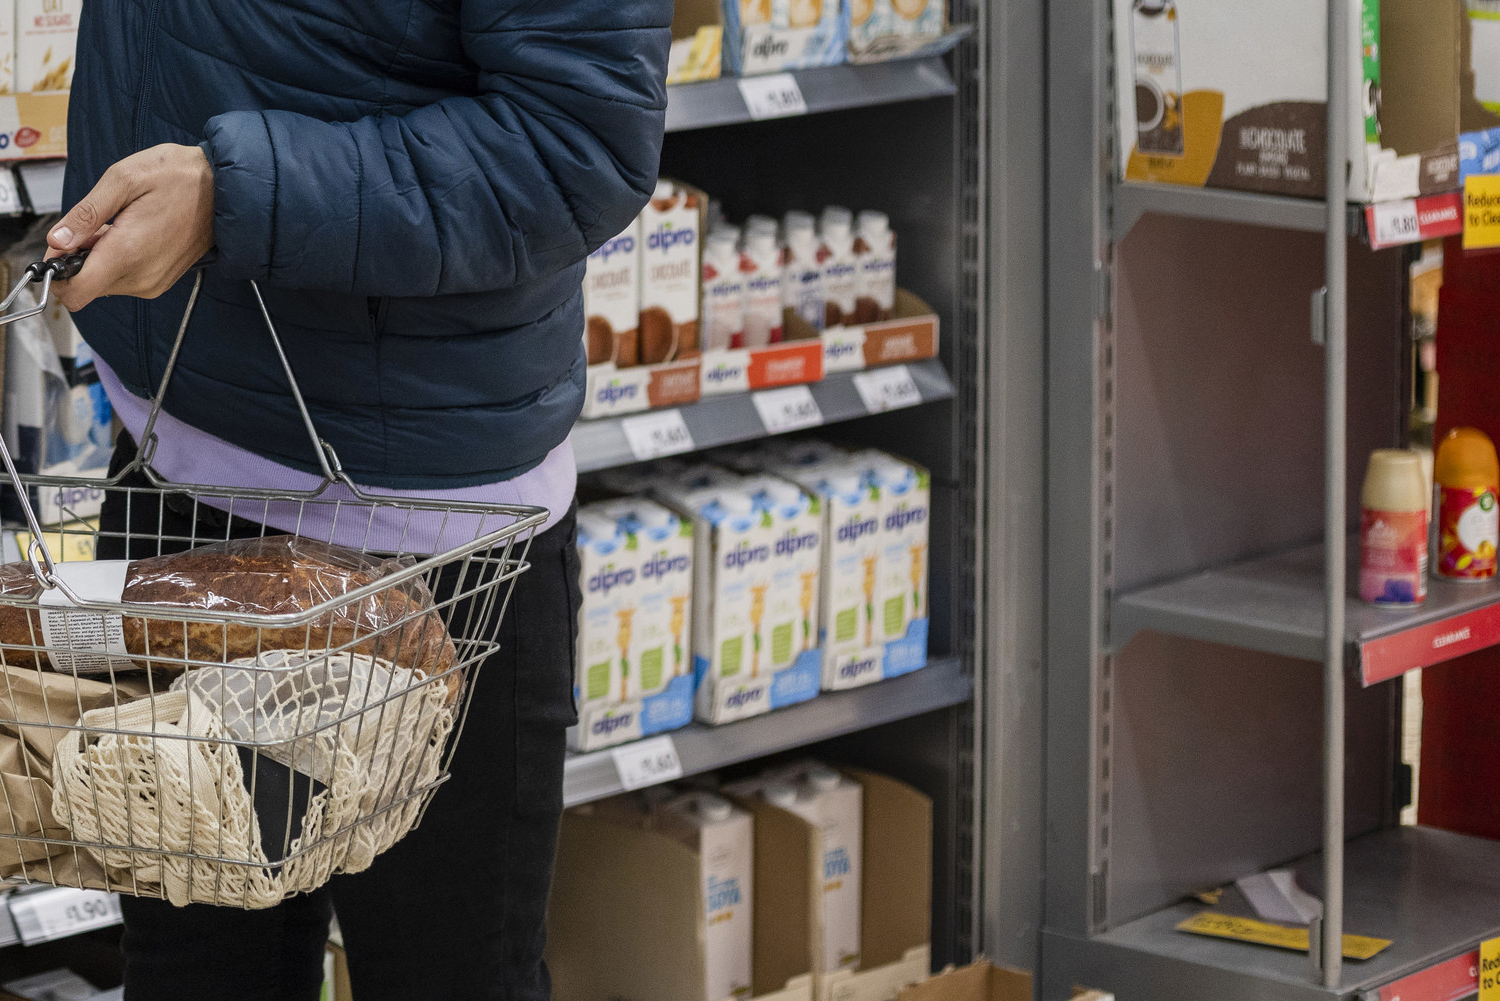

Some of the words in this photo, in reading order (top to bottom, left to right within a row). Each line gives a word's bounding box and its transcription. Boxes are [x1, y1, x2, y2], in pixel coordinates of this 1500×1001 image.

[1420, 207, 1458, 225] CLEARANCE
[647, 222, 695, 253] alpro
[838, 517, 879, 543] alpro
[724, 542, 770, 571] alpro
[589, 566, 636, 595] alpro
[1433, 627, 1472, 650] CLEARANCE
